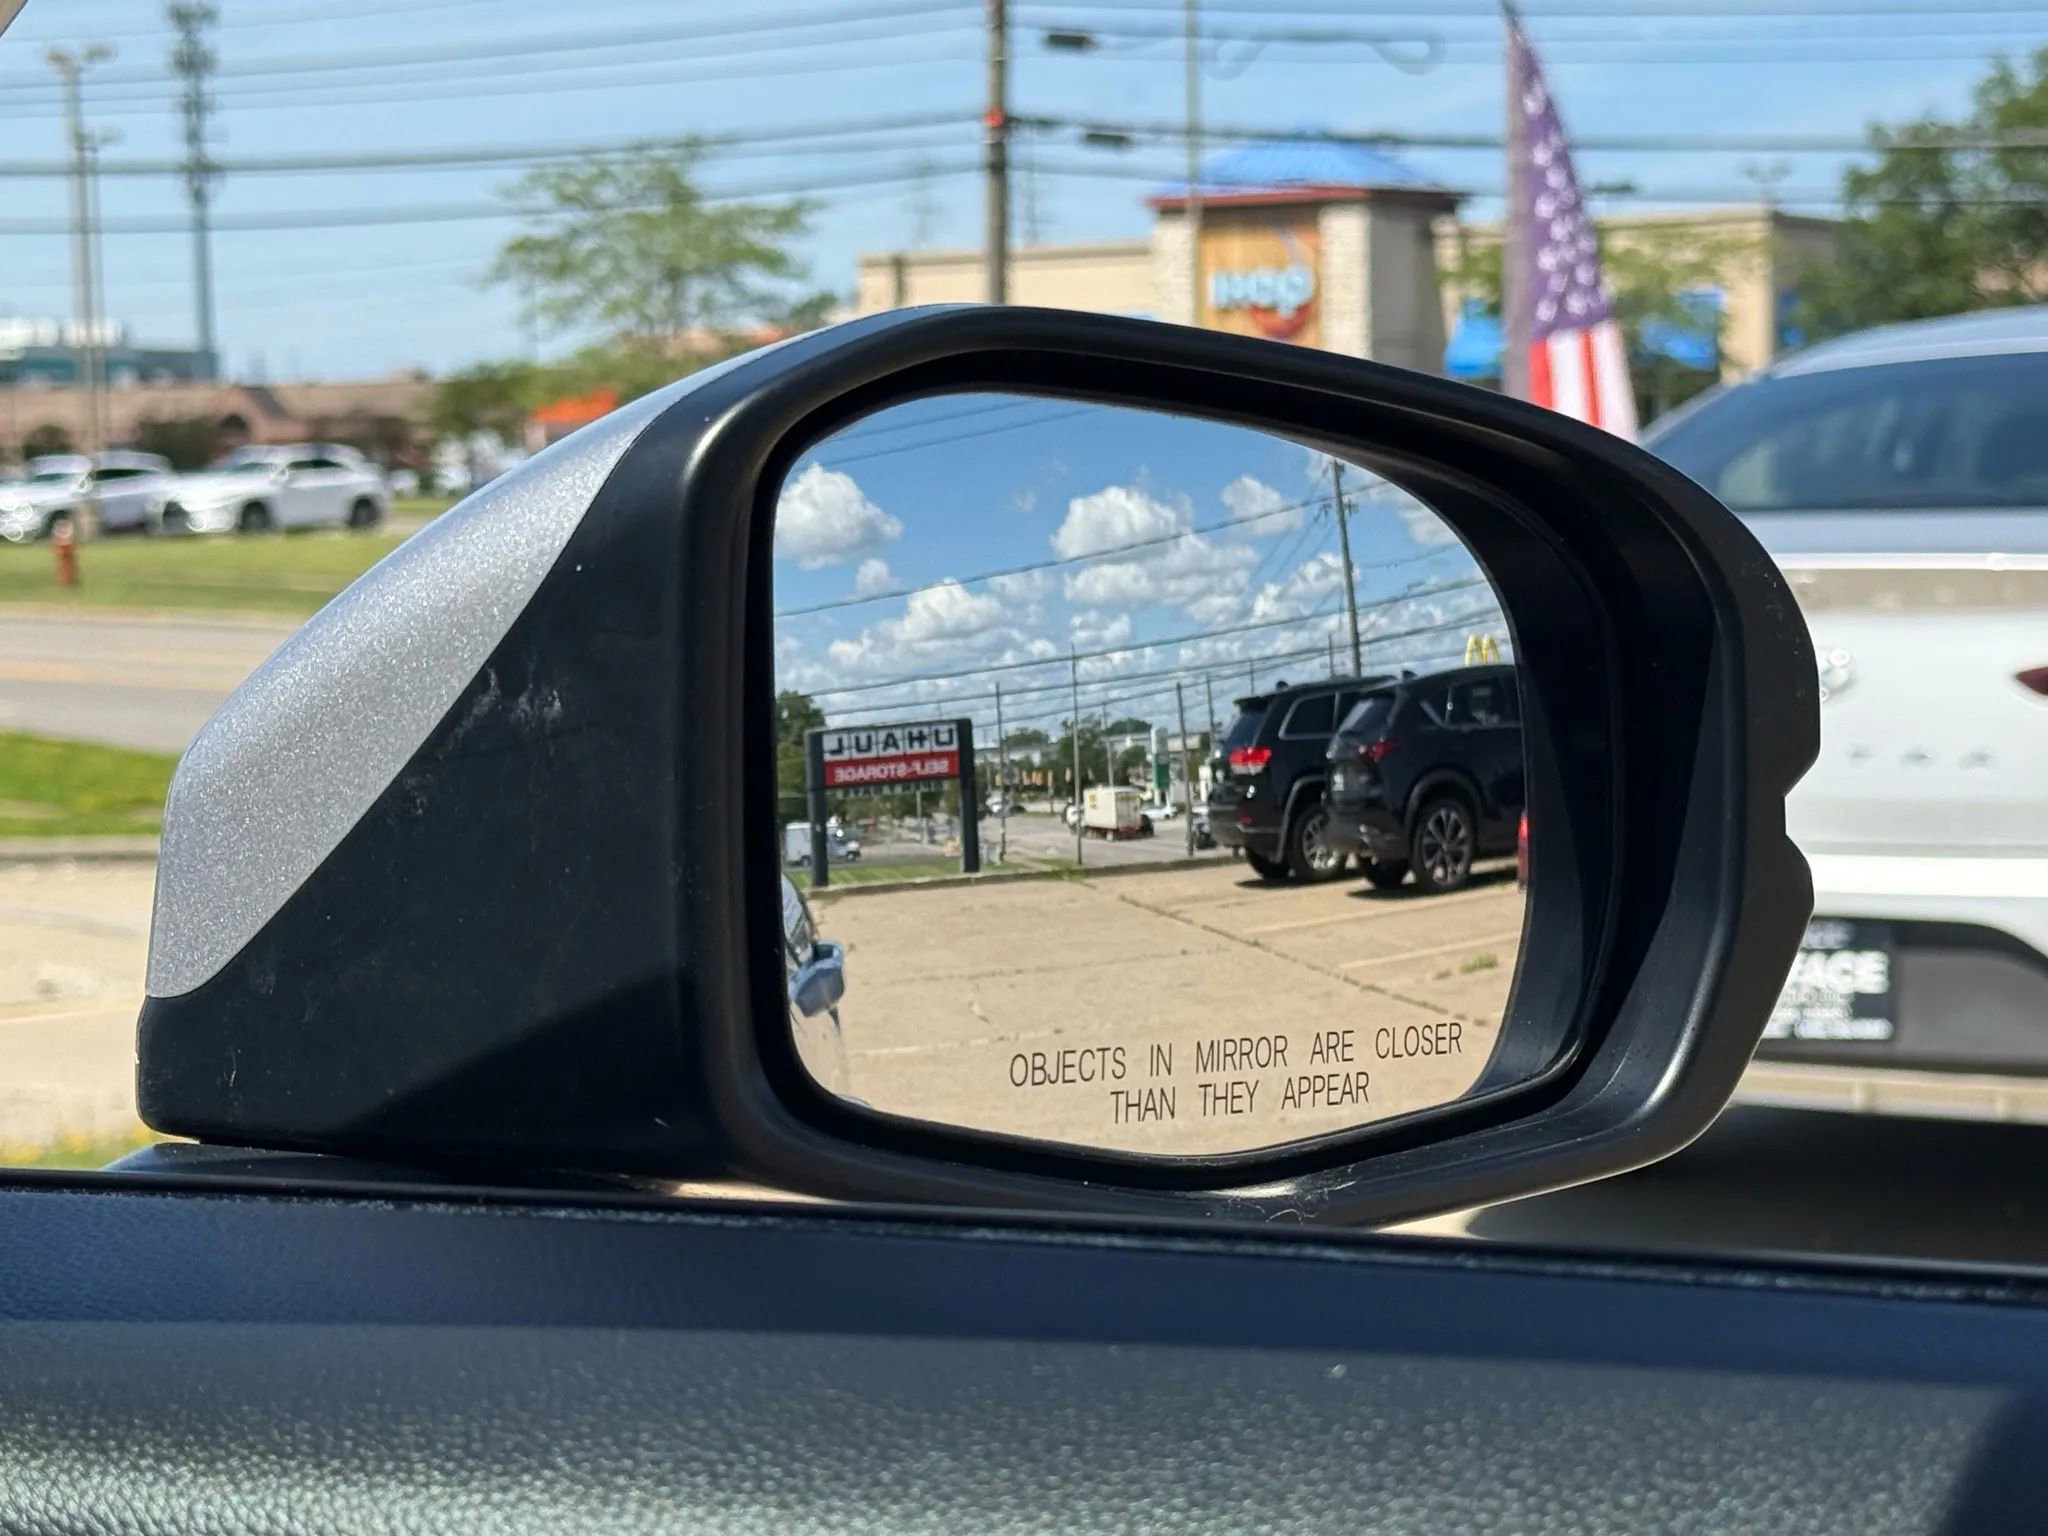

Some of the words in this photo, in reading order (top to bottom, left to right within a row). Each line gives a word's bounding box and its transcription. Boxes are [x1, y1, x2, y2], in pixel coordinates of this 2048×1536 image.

[1009, 1046, 1127, 1087] OBJECTS
[1150, 1043, 1172, 1077] IN
[1195, 1035, 1288, 1074] MIRROR
[1310, 1030, 1355, 1065] ARE
[1375, 1022, 1463, 1060] CLOSER
[1110, 1086, 1176, 1124] THAN
[1198, 1079, 1259, 1117] THEY
[1281, 1071, 1369, 1110] APPEAR
